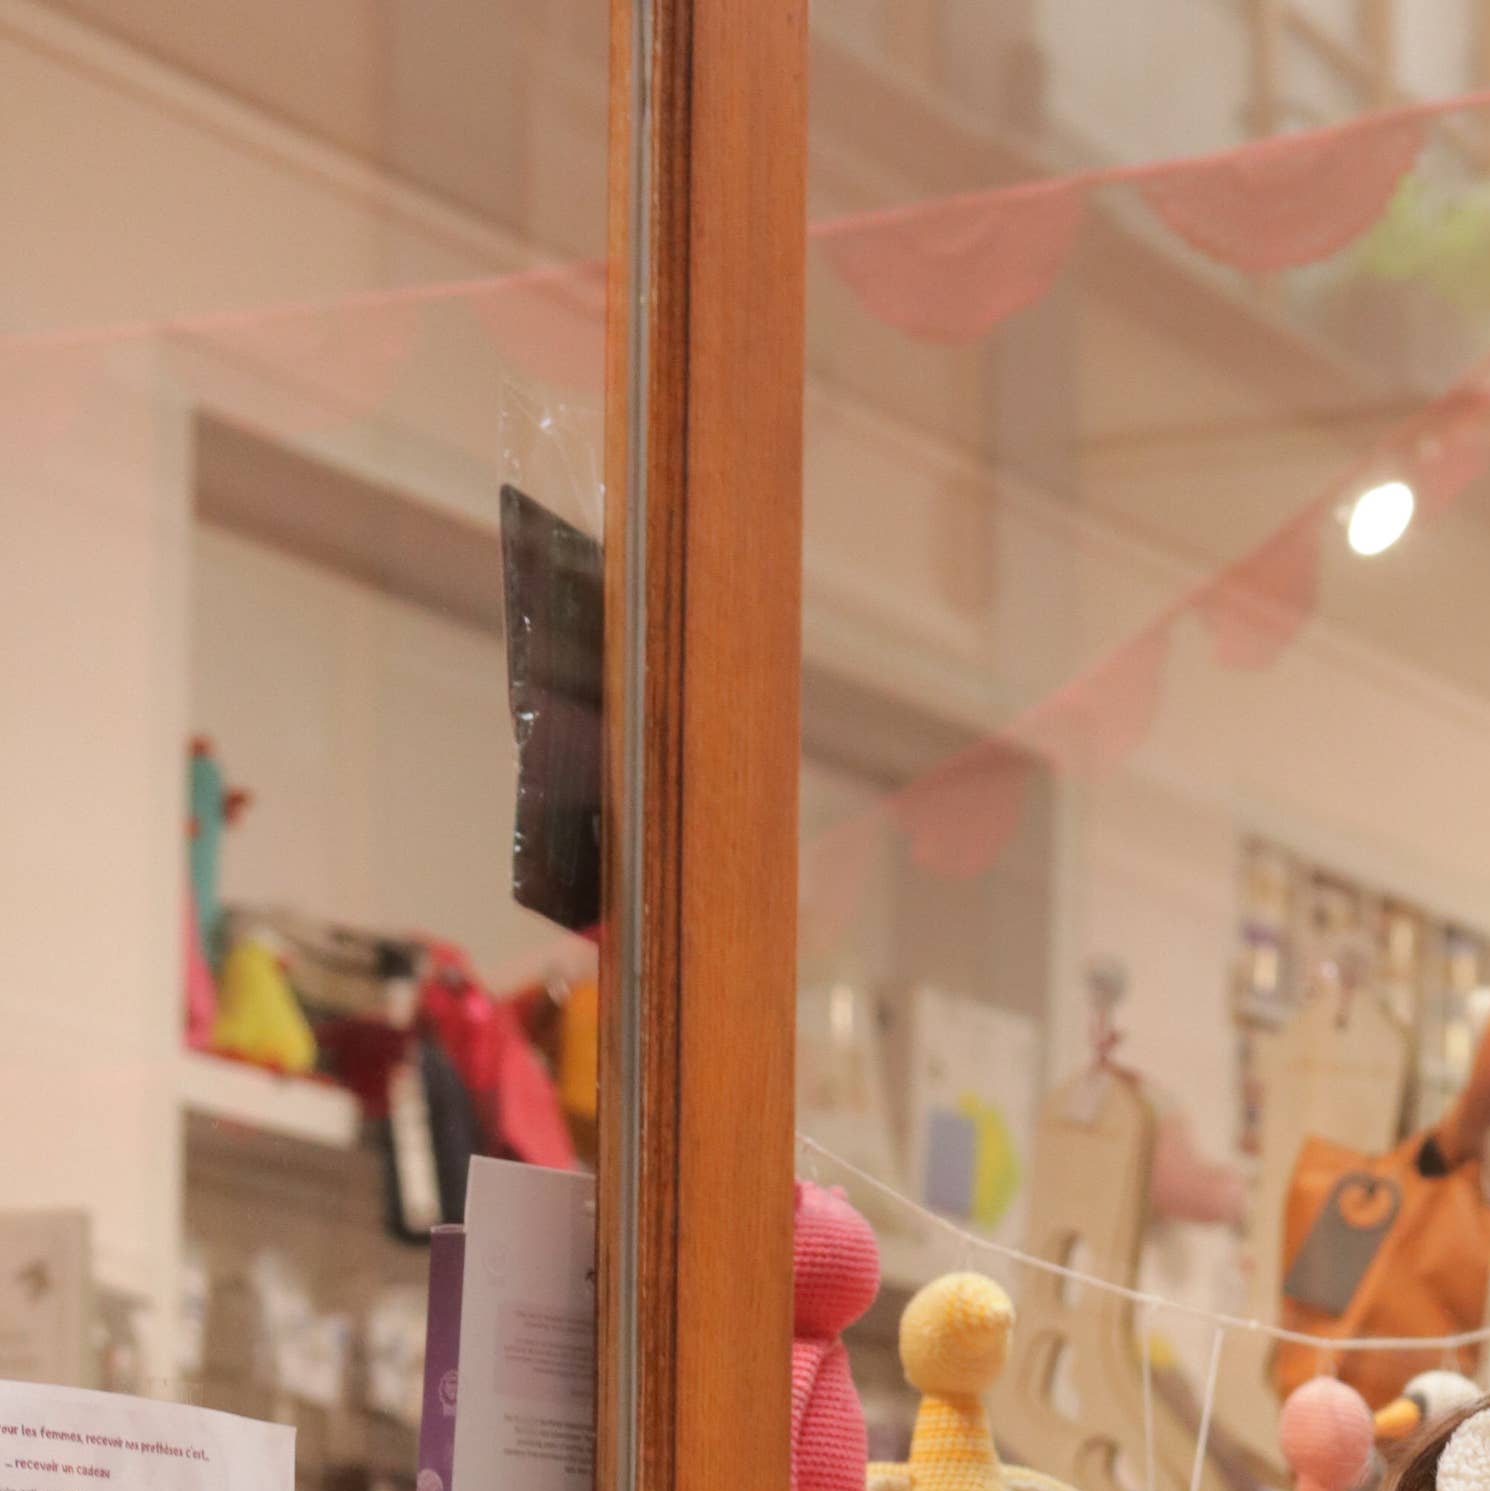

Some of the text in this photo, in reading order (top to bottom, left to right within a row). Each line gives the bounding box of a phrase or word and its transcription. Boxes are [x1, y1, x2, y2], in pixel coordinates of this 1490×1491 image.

[21, 1424, 37, 1438] les
[15, 1459, 59, 1472] recevoir
[61, 1463, 74, 1474] un
[76, 1465, 111, 1480] cadeau
